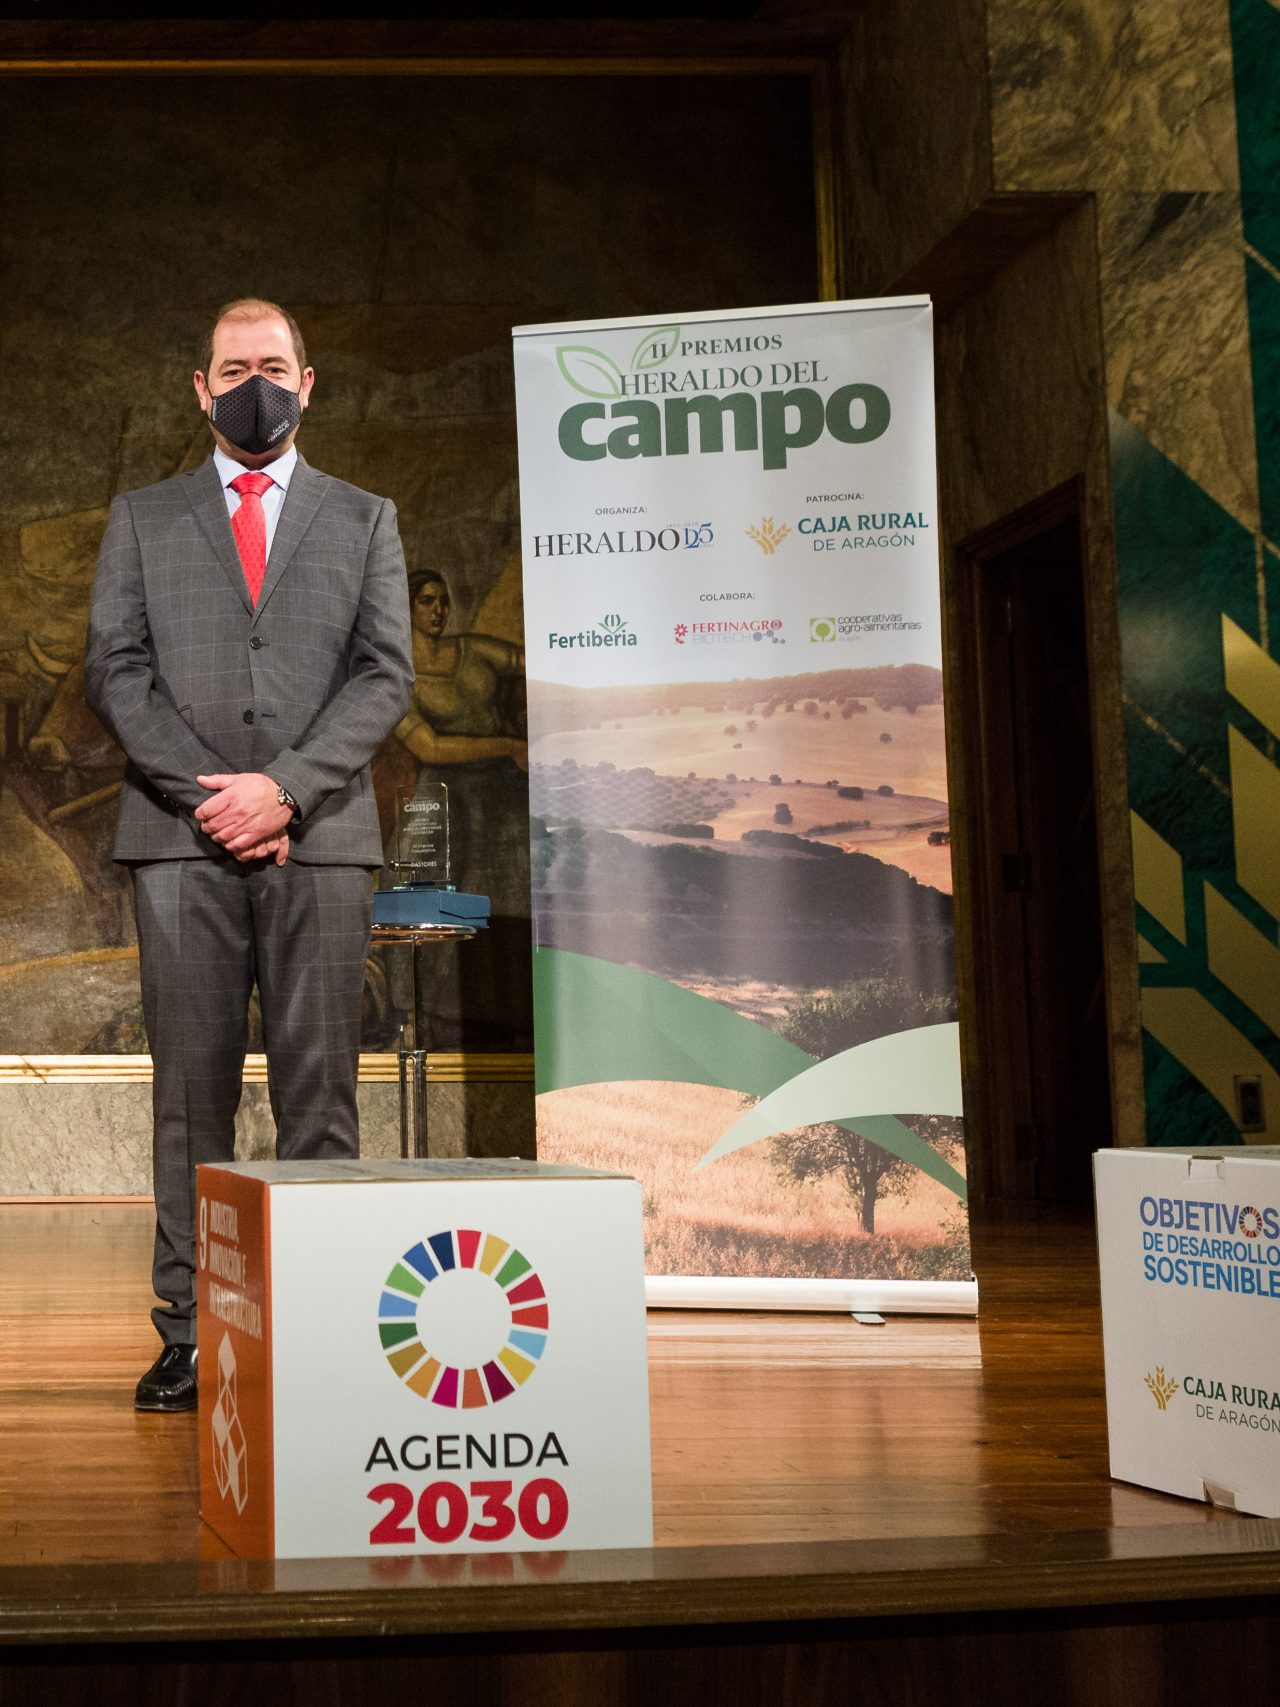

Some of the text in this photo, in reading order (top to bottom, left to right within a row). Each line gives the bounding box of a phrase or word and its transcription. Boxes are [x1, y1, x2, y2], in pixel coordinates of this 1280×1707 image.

[651, 334, 783, 359] II PREMIOS
[619, 360, 828, 397] HERALDO DEL
[557, 382, 891, 470] campo
[595, 506, 648, 516] ORGANIZA:
[806, 493, 865, 503] PATROCINA:
[798, 512, 929, 535] CAJA RURAL
[533, 529, 680, 557] HERALDO
[813, 533, 915, 551] DE ARAGÓN
[700, 592, 756, 602] COLABORA:
[692, 619, 783, 634] FERTINAGRO
[838, 613, 903, 624] cooperativas
[839, 621, 922, 634] agro-alimentarias
[549, 630, 638, 649] Fertiberia
[403, 803, 440, 814] campo
[1140, 1196, 1280, 1240] OBJETIVOS
[199, 1196, 207, 1271] 9
[1143, 1231, 1280, 1266] DE DESARROLLO
[1144, 1254, 1280, 1299] SOSTENIBLE
[1183, 1376, 1280, 1411] CAJA RURA
[1196, 1404, 1280, 1433] DE ARAGÓN
[364, 1431, 570, 1473] AGENDA
[365, 1477, 570, 1546] 2030
